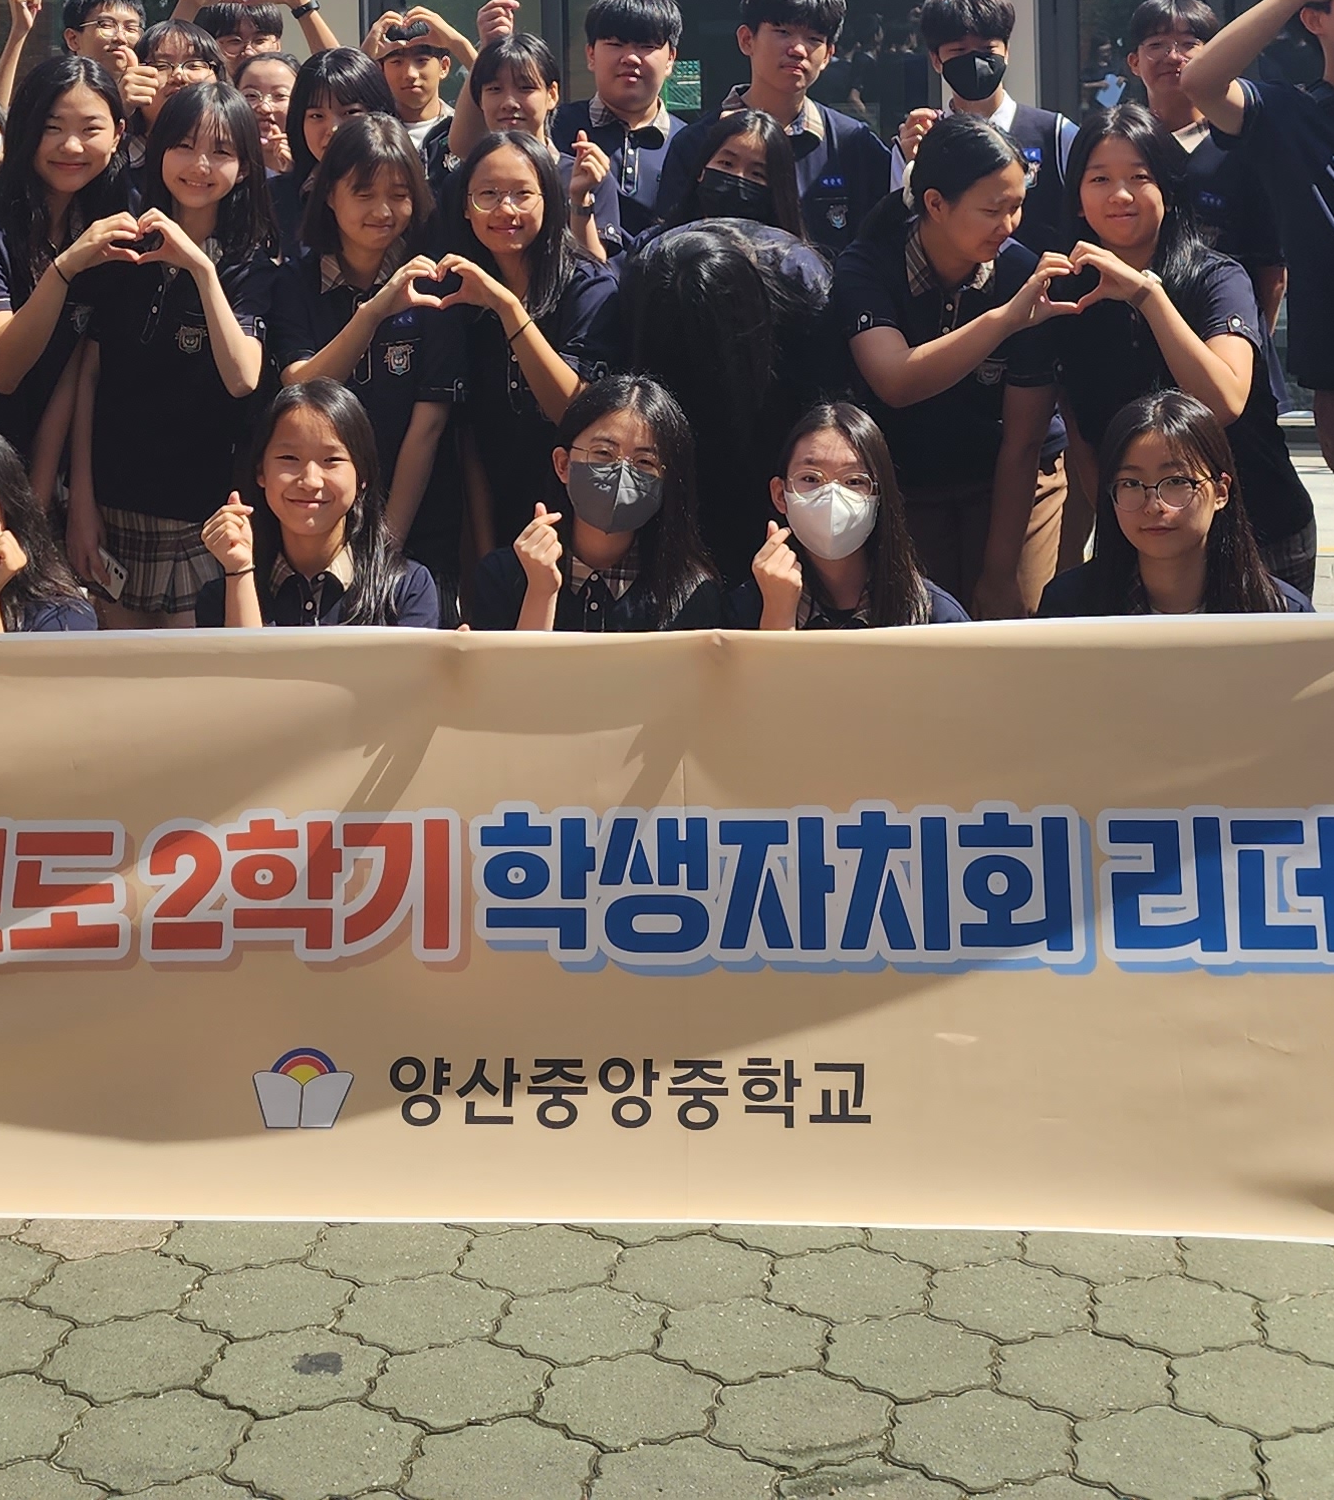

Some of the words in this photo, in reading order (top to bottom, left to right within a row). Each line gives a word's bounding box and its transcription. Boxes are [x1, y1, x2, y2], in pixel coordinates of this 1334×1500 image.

[149, 815, 452, 954] 2학기
[479, 810, 1077, 953] 학생자치회
[389, 1056, 872, 1128] 양산중앙중학교
